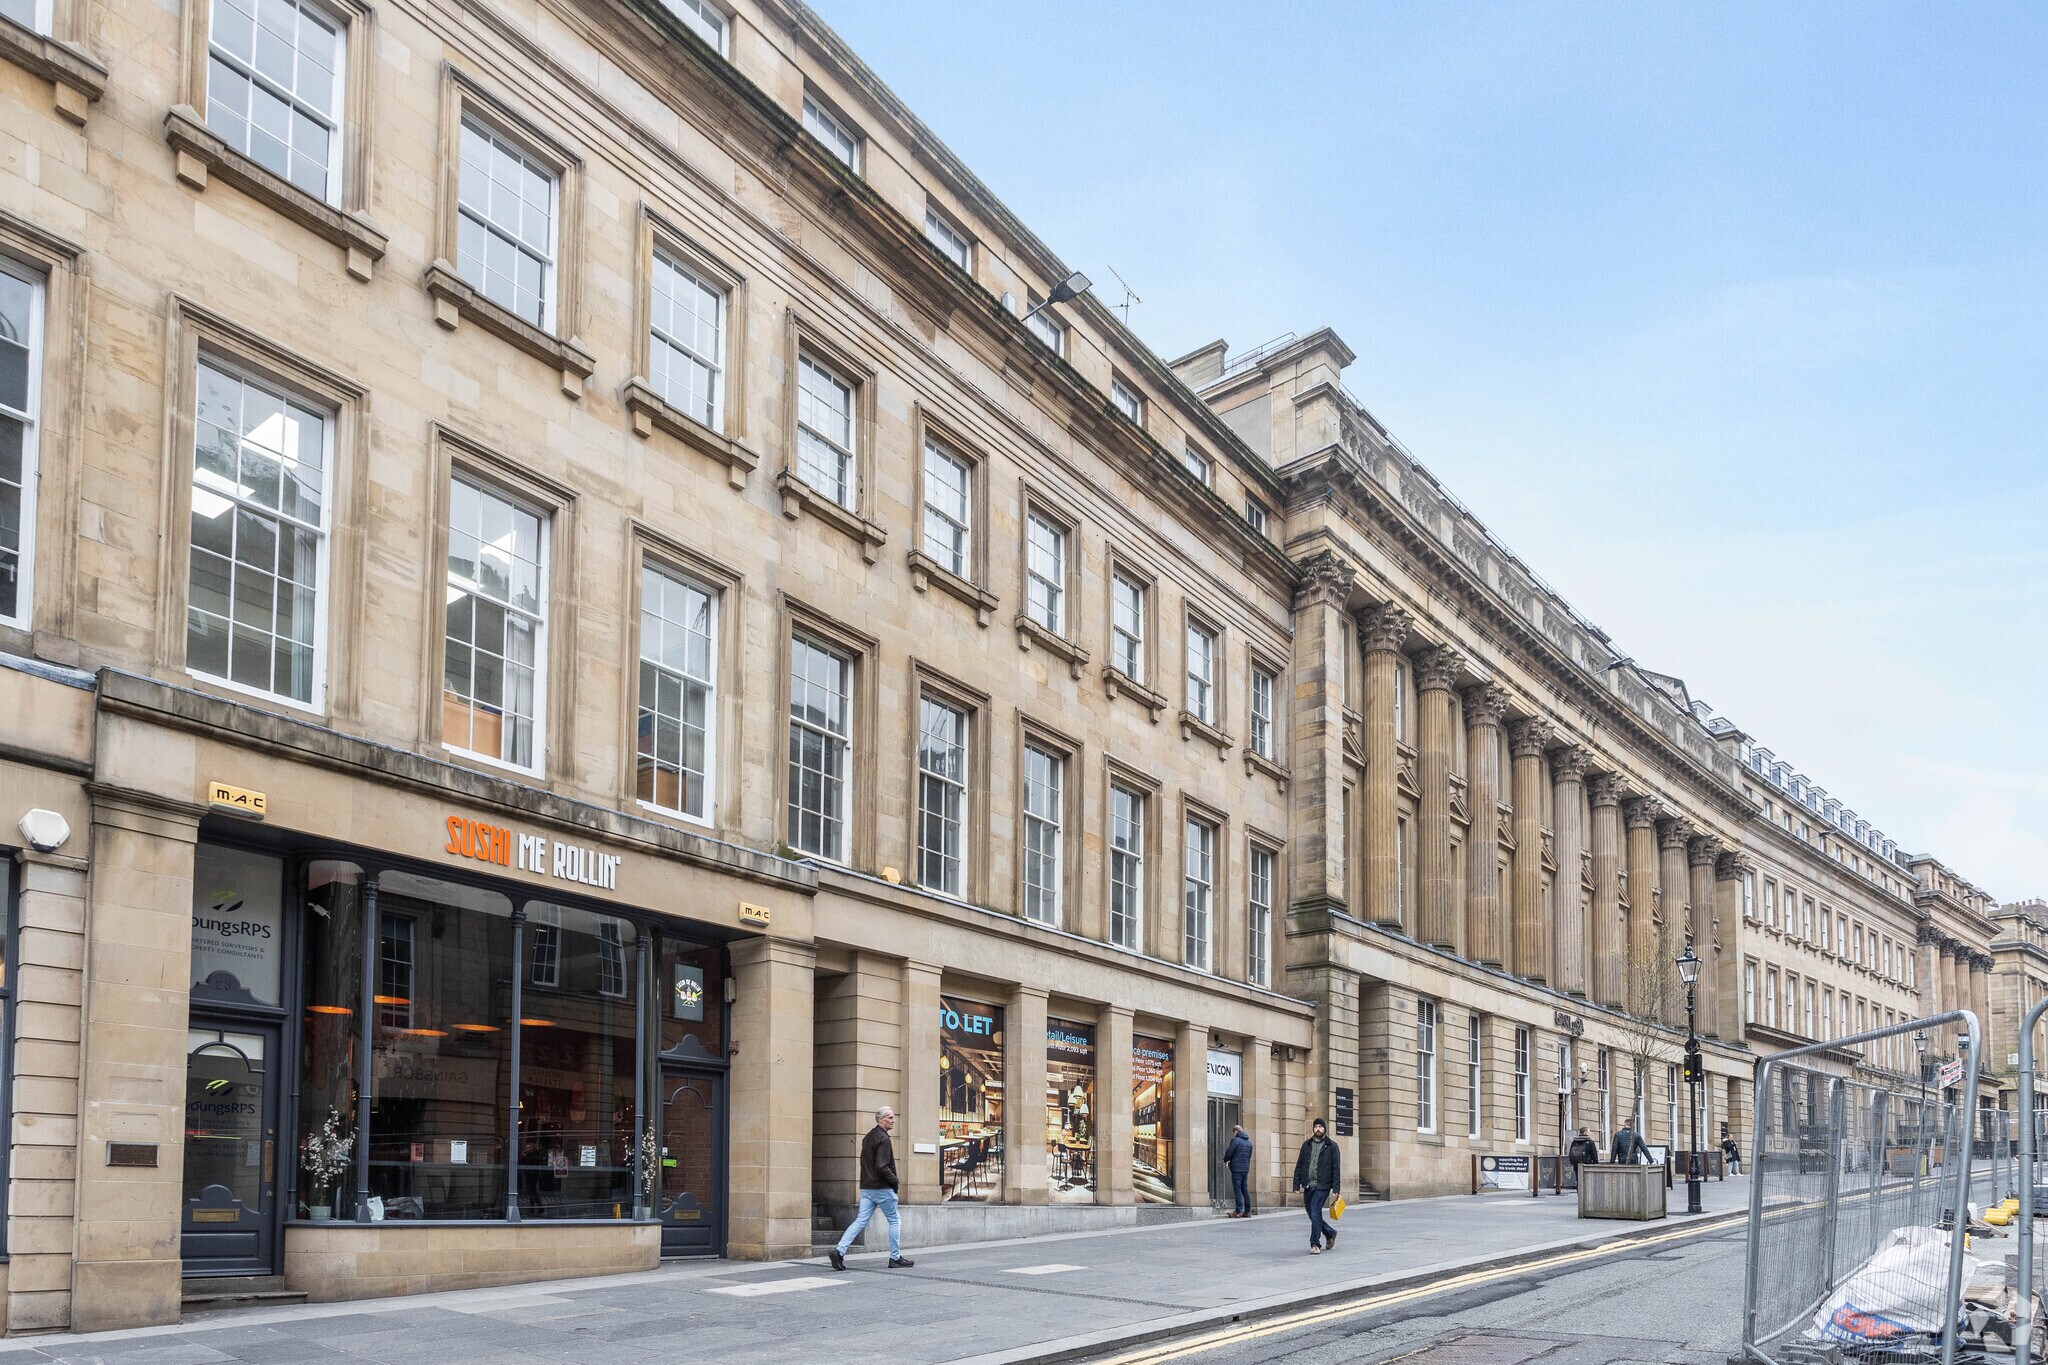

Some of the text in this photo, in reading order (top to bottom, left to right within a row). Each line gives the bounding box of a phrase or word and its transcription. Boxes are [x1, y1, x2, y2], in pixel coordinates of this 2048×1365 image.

[446, 816, 622, 890] SUSHI ME ROLLIN'
[192, 916, 271, 939] oungsRPS
[191, 944, 264, 959] OPERTY CONSULTANTS
[192, 937, 219, 946] ARTERED
[221, 941, 258, 952] SURVEYORS
[939, 1008, 993, 1036] TO LET
[1046, 1030, 1087, 1046] etail/Leisure
[1055, 1043, 1066, 1051] Floor
[1067, 1045, 1079, 1053] 2,093
[1142, 1049, 1169, 1061] premises
[1207, 1063, 1232, 1077] EXICON
